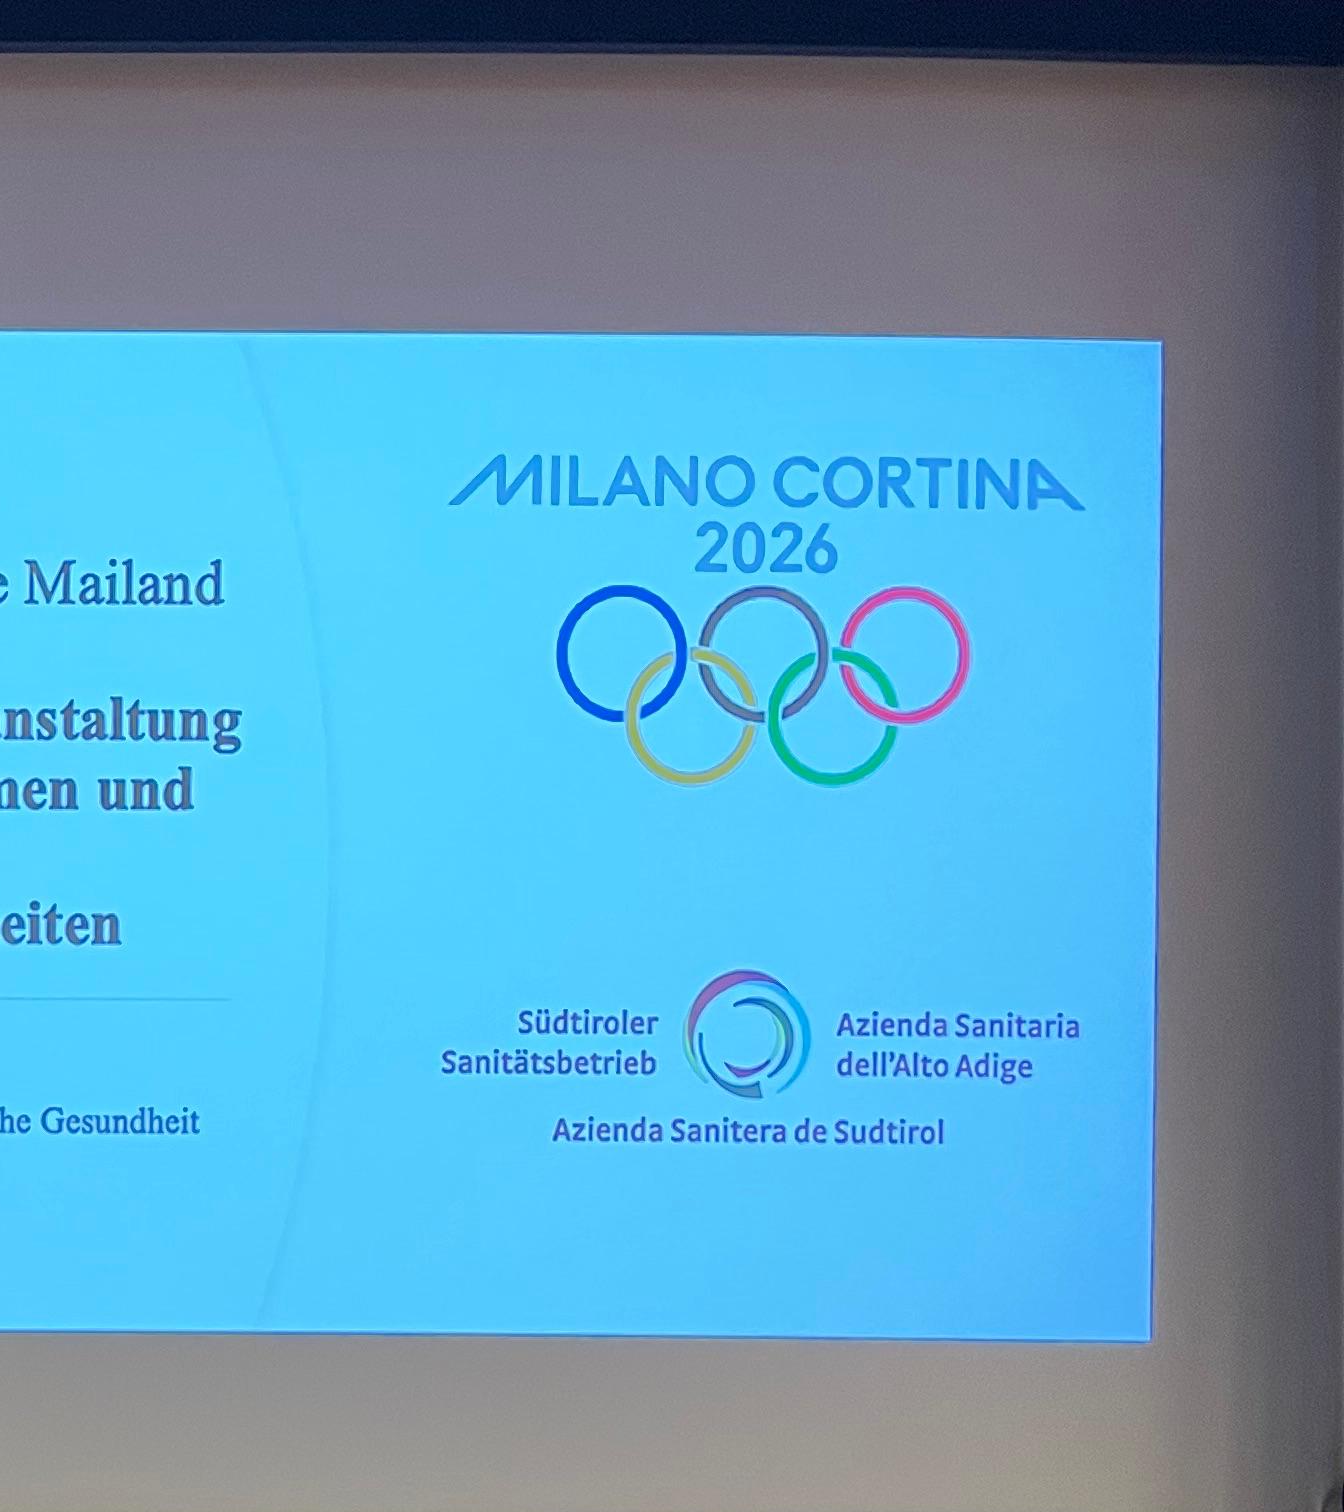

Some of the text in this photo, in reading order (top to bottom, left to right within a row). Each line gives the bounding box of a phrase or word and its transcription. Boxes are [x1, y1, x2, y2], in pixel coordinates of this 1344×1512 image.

[449, 454, 1086, 511] MILANO CORTINA
[694, 520, 838, 574] 2026
[24, 558, 226, 606] Mailand
[97, 765, 195, 812] und
[518, 1008, 660, 1036] Südtiroler
[836, 1010, 1081, 1040] Azienda Sanitaria
[441, 1048, 657, 1077] Sanitätsbetrieb
[954, 1052, 1034, 1084] Adige
[40, 1106, 201, 1136] Gesundheit
[552, 1115, 945, 1146] Azienda Sanitera de Sudtirol
